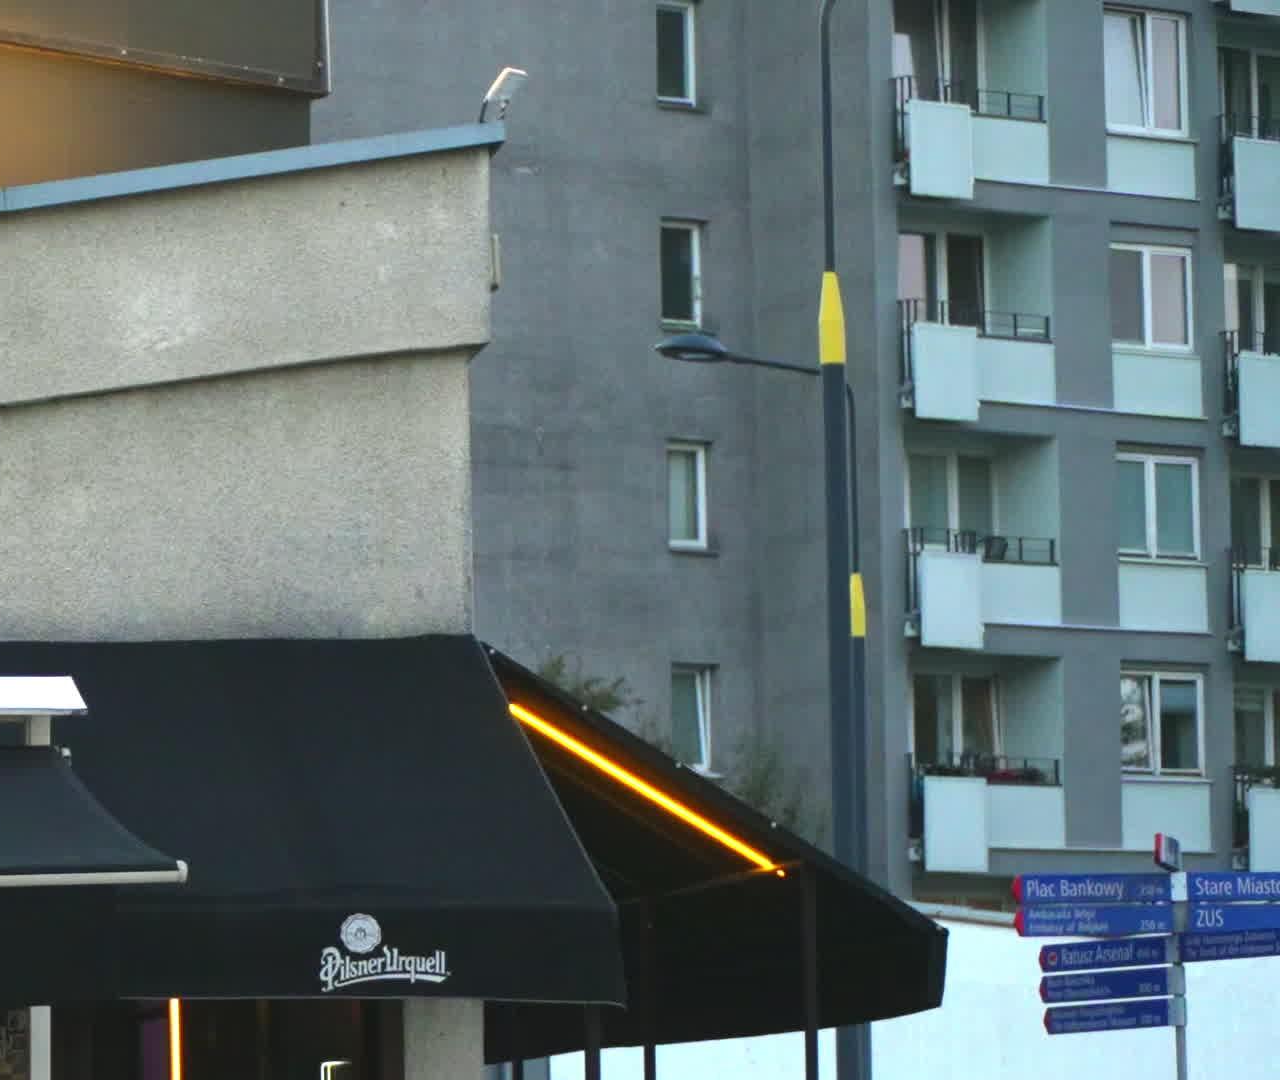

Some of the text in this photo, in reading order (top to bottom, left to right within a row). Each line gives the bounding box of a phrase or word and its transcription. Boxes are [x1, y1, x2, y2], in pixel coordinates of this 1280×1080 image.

[1027, 879, 1124, 900] Plac Bankowy
[1195, 878, 1232, 895] Stare
[1196, 909, 1224, 927] ZUS
[320, 944, 446, 992] Pilsner Urquell
